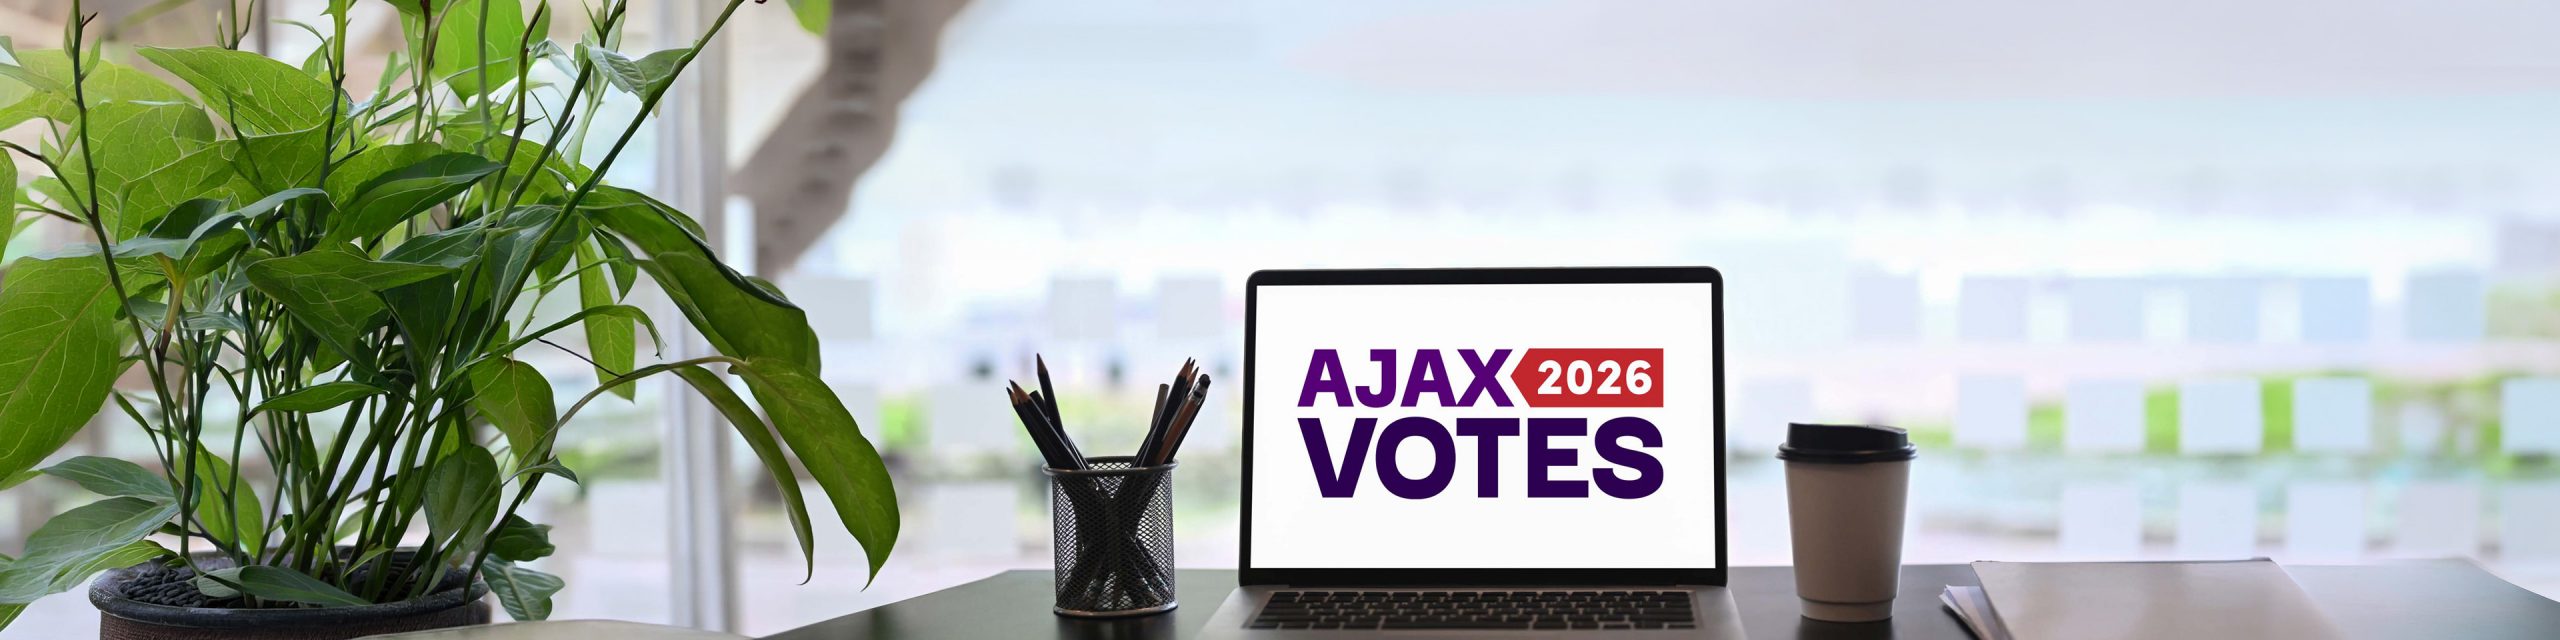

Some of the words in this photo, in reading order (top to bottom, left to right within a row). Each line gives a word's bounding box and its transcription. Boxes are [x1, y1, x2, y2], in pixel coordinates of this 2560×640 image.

[1297, 349, 1515, 408] AJAX
[1537, 359, 1653, 395] 2026
[1297, 416, 1664, 500] VOTES
